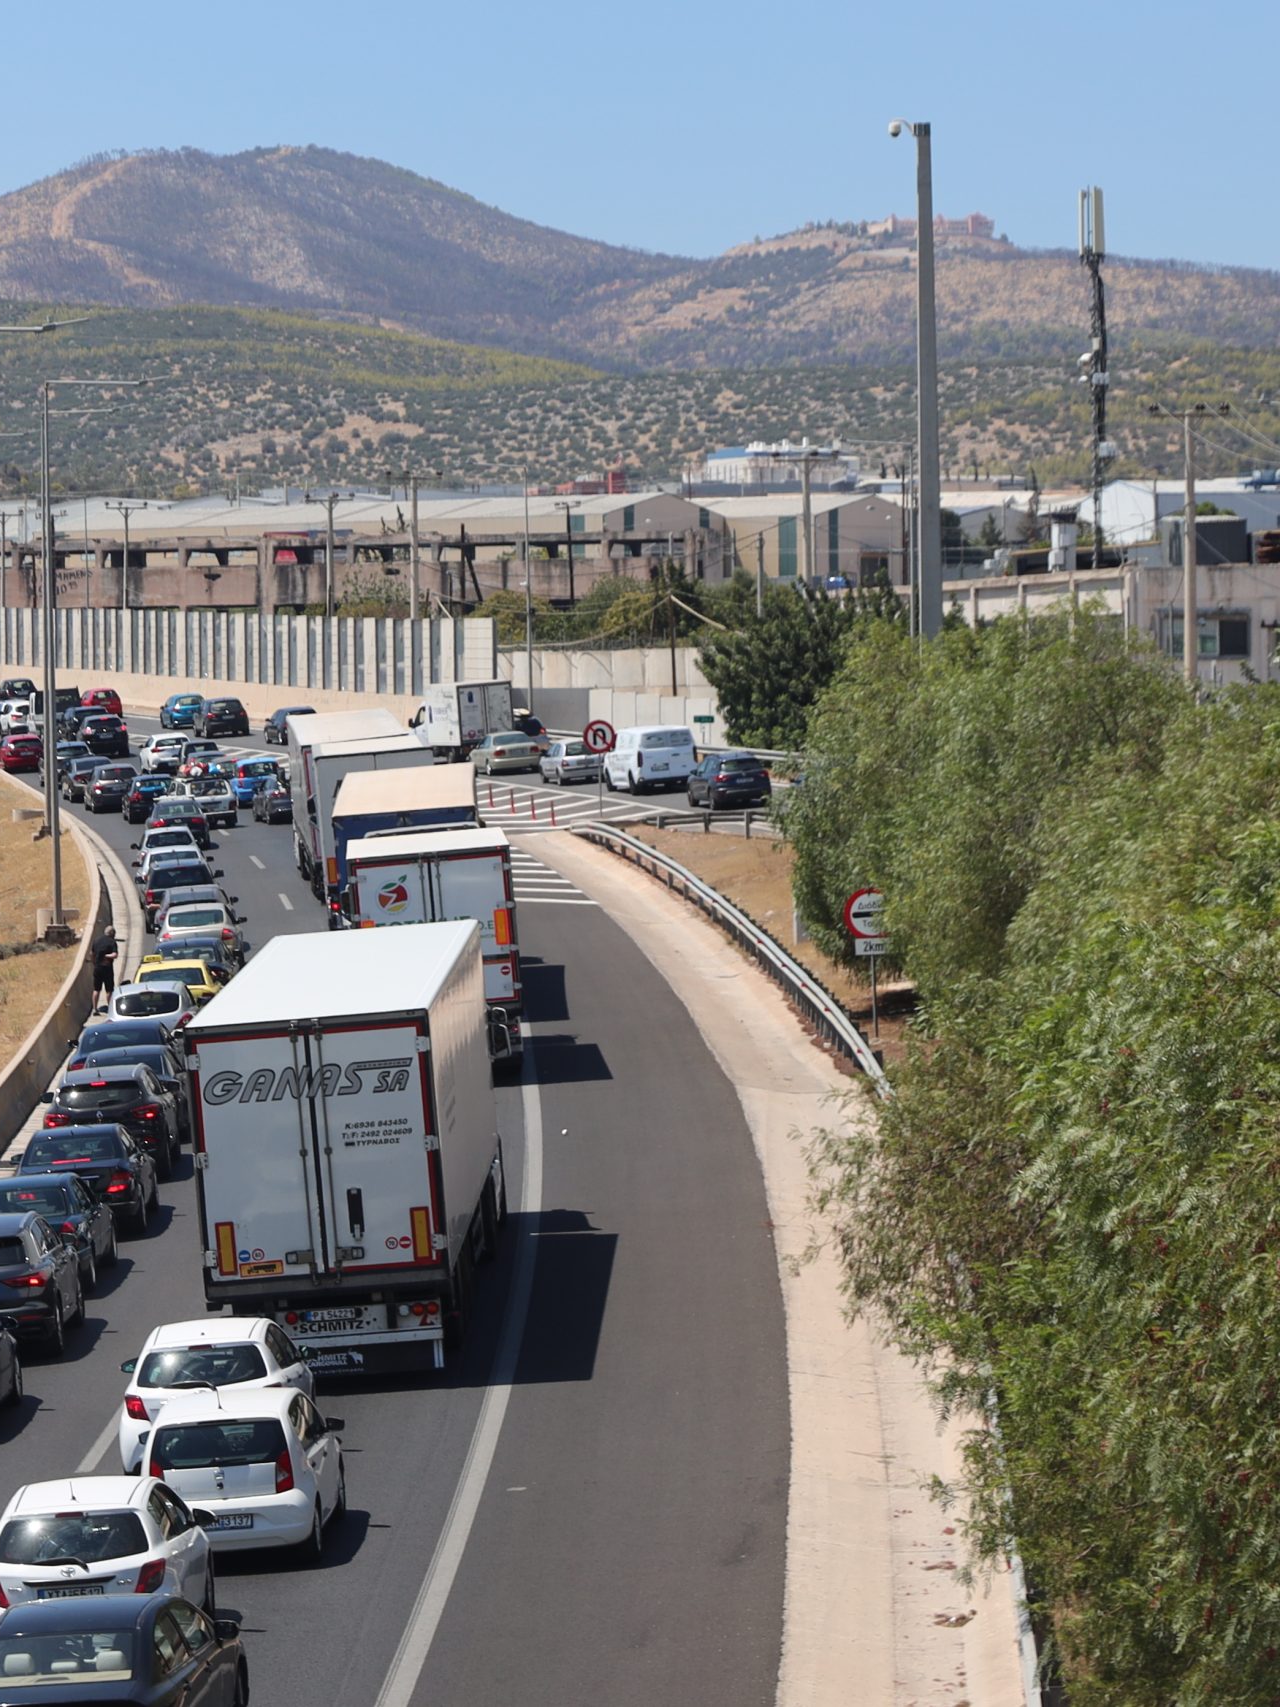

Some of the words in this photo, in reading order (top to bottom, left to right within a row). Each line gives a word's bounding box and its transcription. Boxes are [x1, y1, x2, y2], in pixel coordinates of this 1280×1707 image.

[863, 941, 885, 953] 2km
[203, 1062, 365, 1105] GANAS
[373, 1069, 410, 1093] SA
[300, 1320, 364, 1333] SCHMITZ
